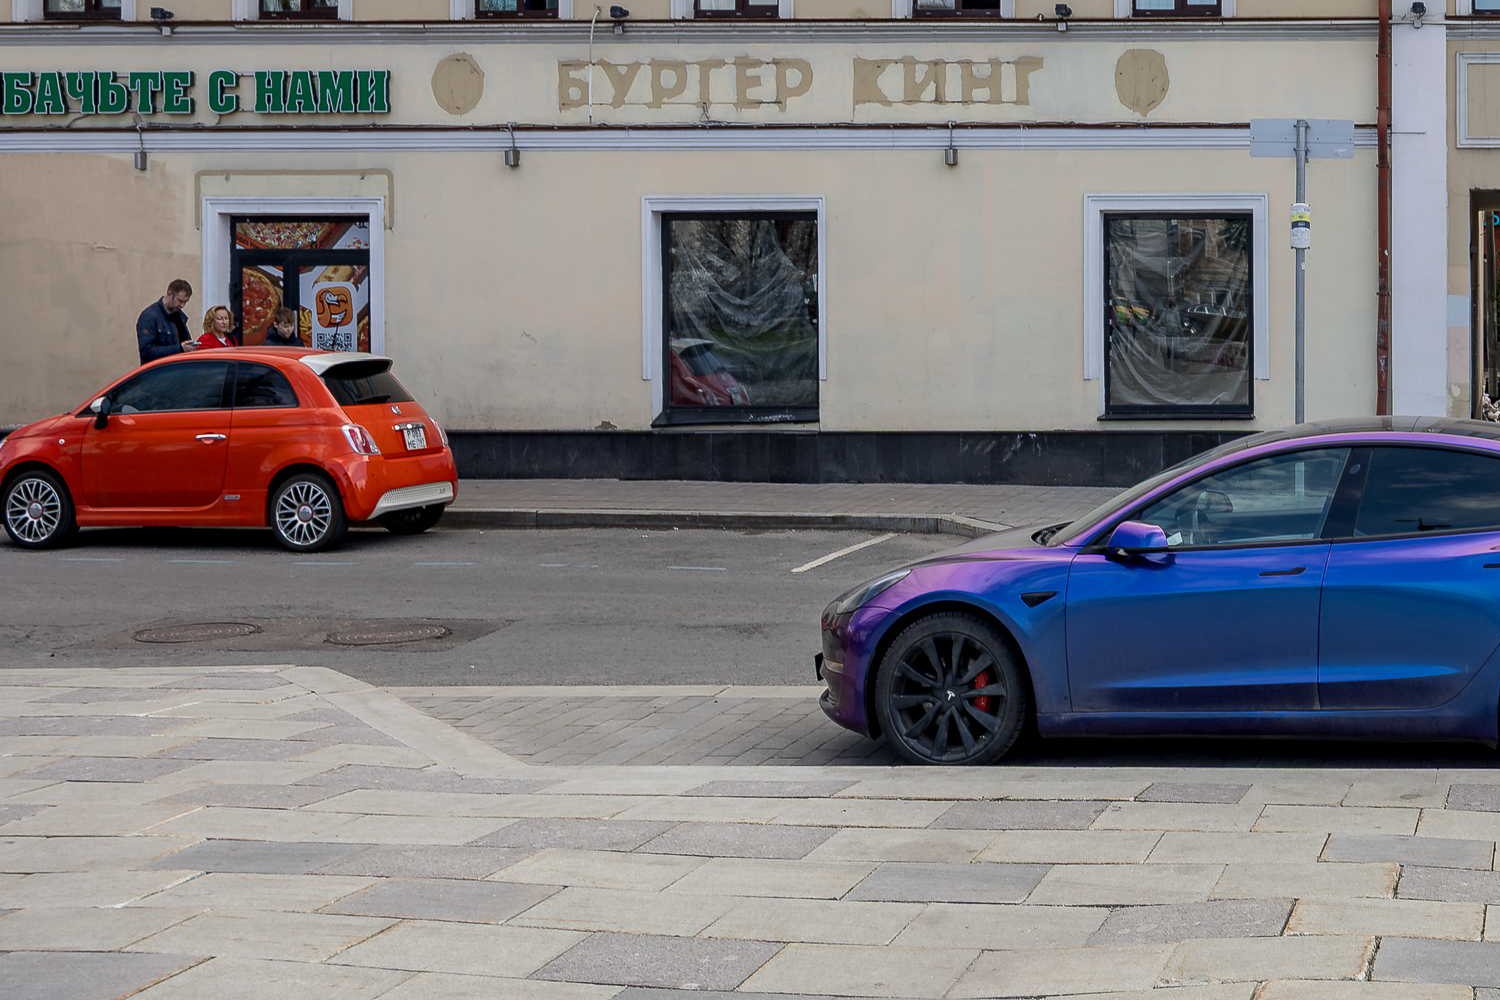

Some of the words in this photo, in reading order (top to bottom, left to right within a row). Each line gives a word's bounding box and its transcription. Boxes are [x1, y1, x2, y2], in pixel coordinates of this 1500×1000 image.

[2, 70, 195, 115] БАЧЬТЕ
[208, 69, 240, 114] С
[253, 69, 392, 114] НАМИ
[558, 55, 813, 113] БУРГЕР
[853, 55, 1044, 110] КИНГ
